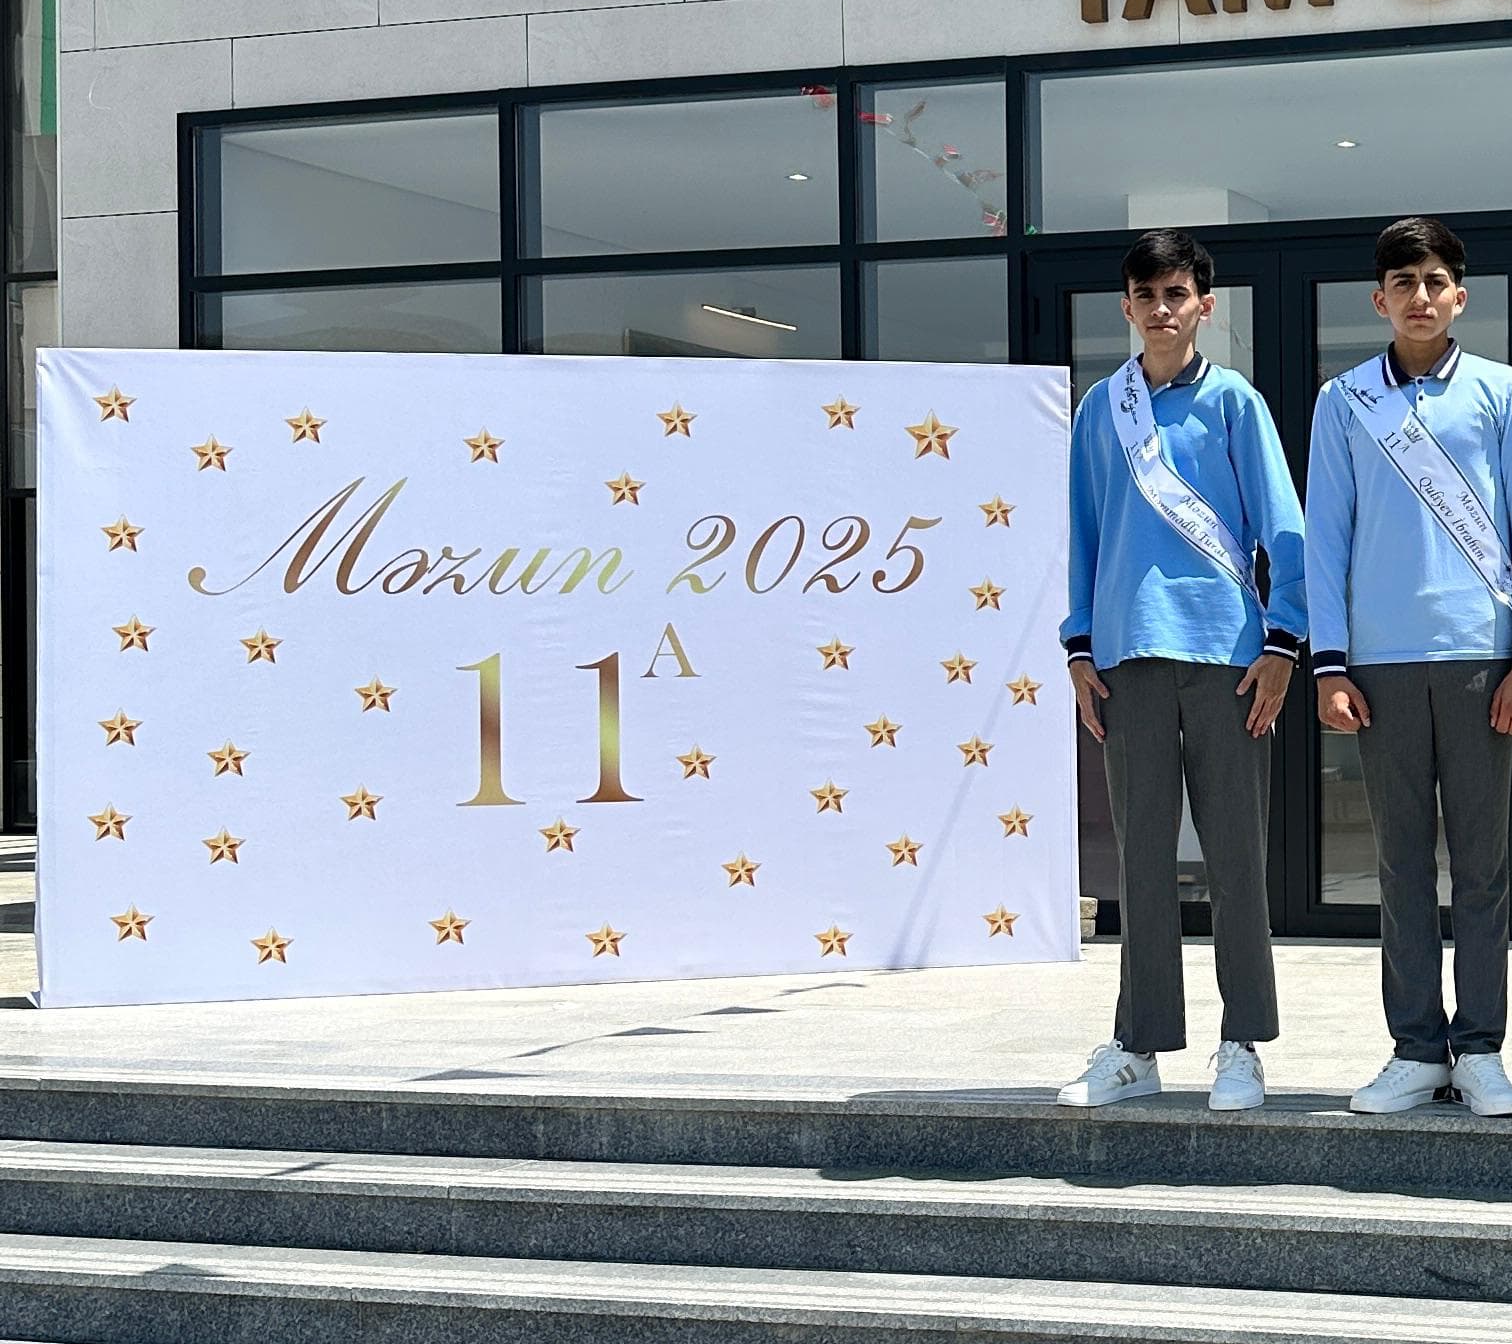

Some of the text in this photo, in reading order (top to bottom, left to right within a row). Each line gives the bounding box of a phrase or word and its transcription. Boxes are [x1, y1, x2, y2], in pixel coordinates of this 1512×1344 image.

[1418, 475, 1455, 520] Quliyev
[1456, 489, 1488, 532] Məzun
[187, 475, 943, 596] Məzun 2025
